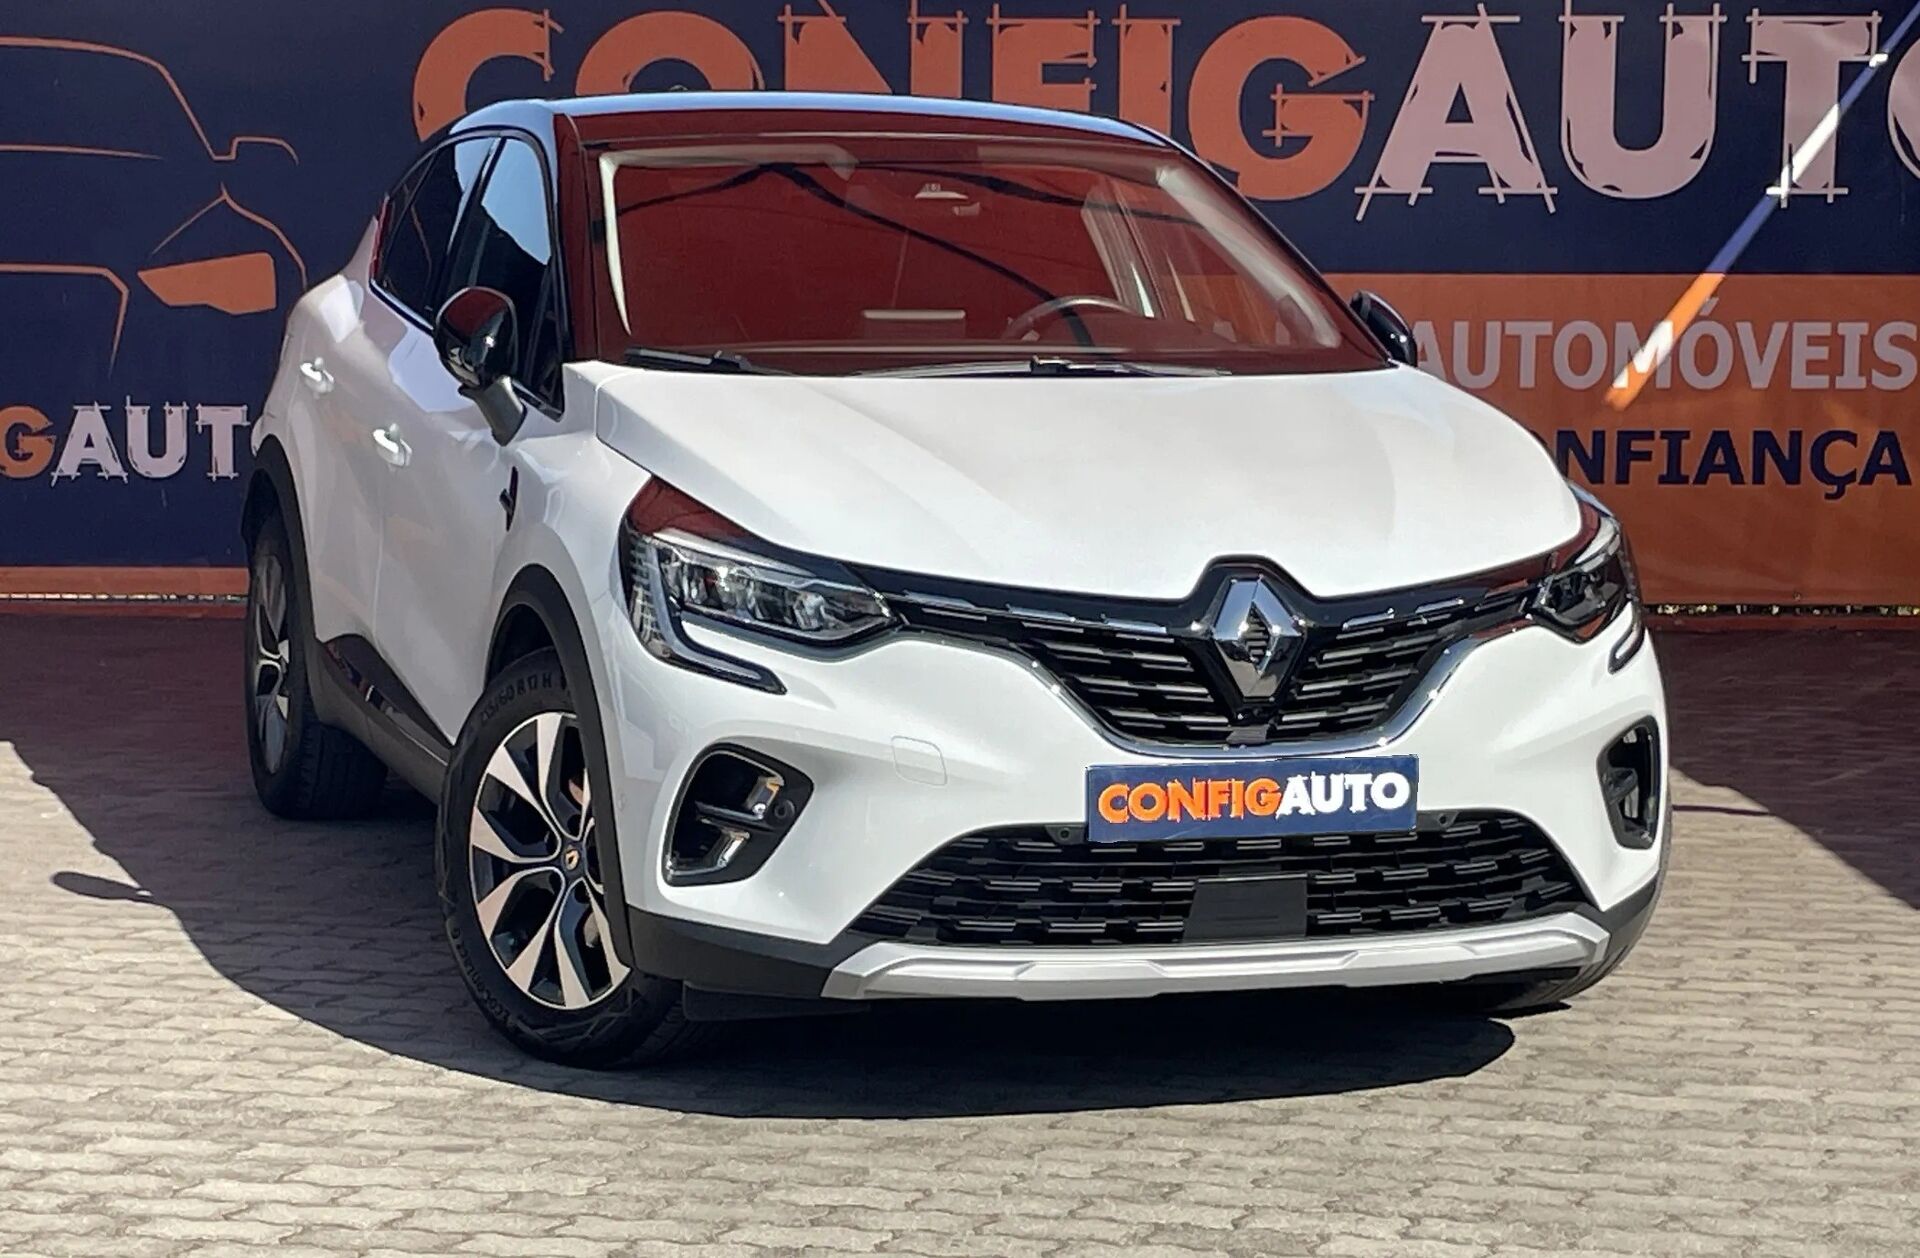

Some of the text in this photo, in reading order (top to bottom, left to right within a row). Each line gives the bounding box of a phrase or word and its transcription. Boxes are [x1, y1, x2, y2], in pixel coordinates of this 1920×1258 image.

[412, 0, 1920, 220] CFIGAUT
[1412, 297, 1918, 390] AUTOMÓVEIS
[1528, 430, 1911, 499] NFIANÇA
[1098, 770, 1410, 823] CONFIGAUTO
